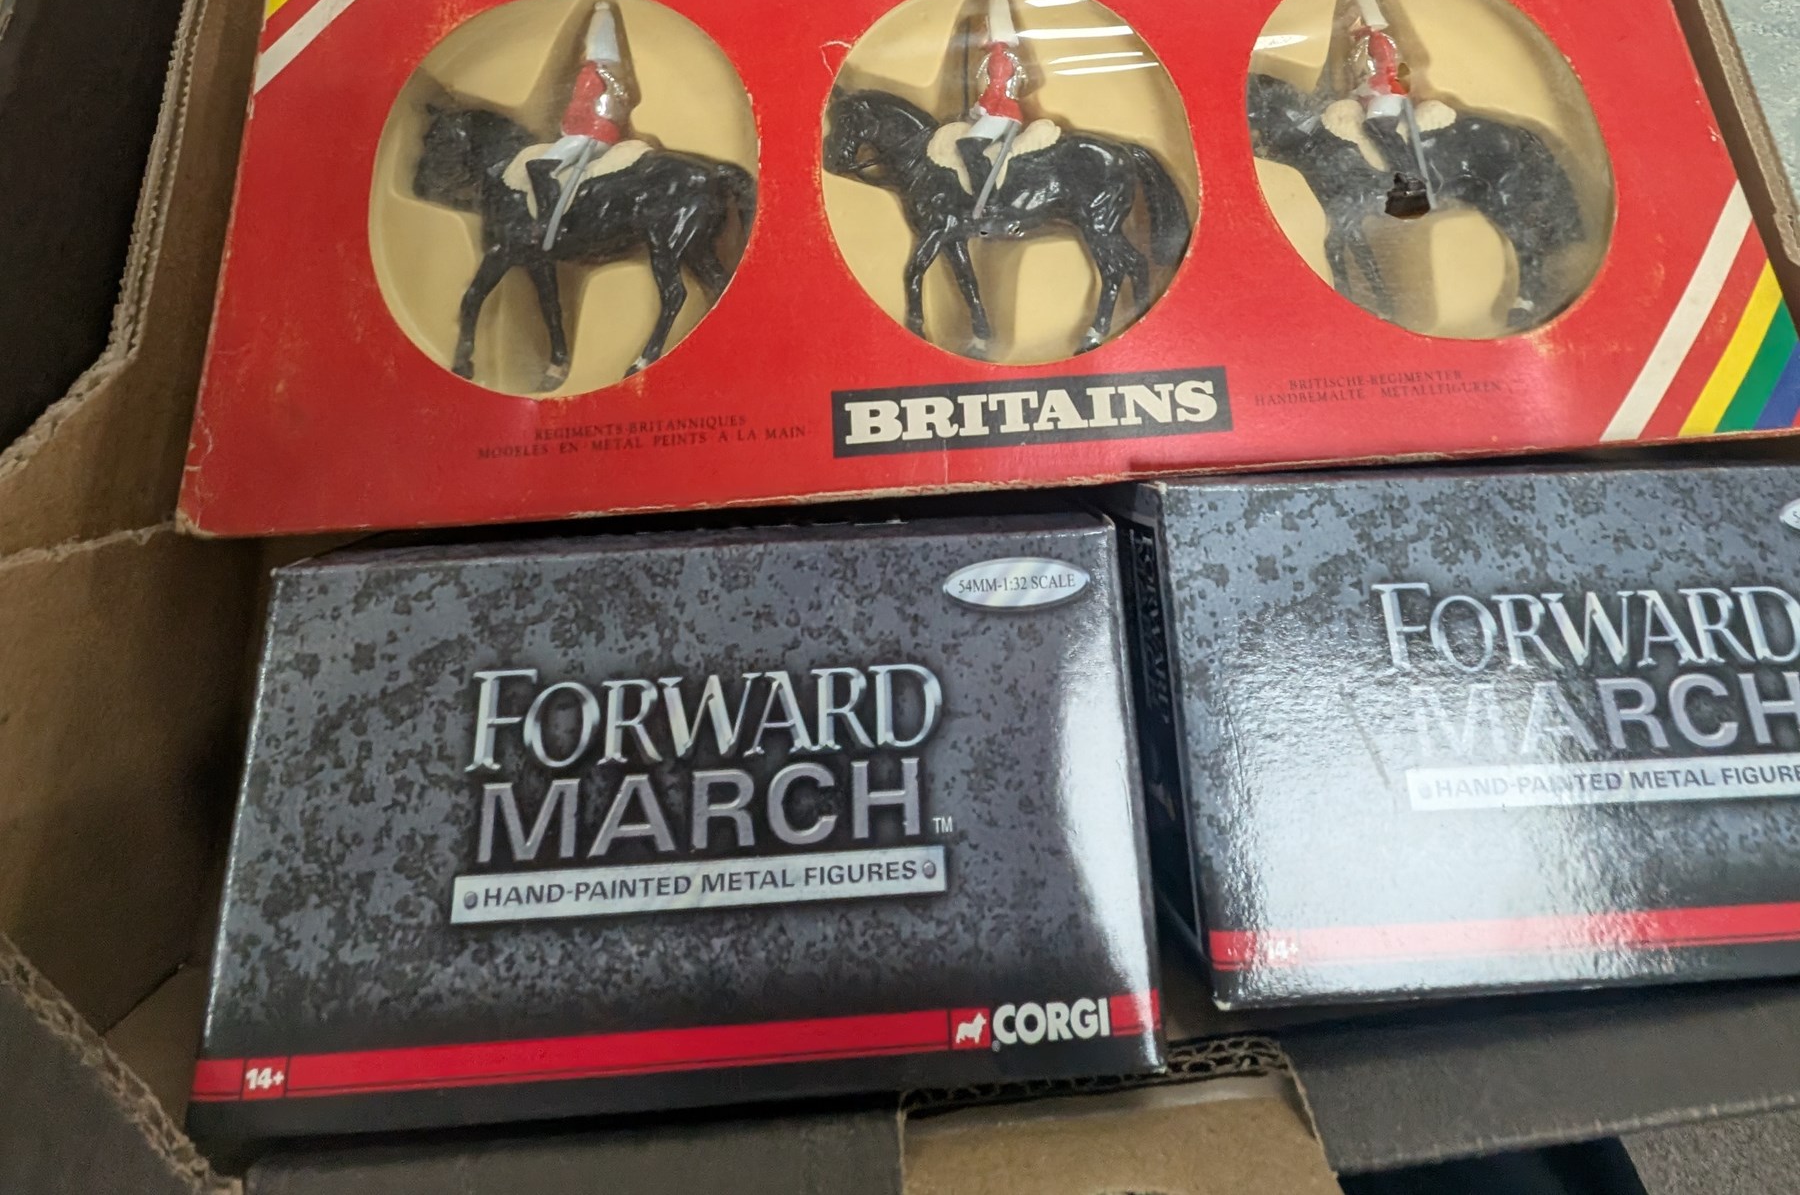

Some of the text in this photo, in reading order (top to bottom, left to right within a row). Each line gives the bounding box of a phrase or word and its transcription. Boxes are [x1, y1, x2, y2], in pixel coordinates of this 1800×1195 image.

[844, 380, 1218, 445] BRITAINS
[559, 440, 579, 454] EN
[653, 432, 708, 448] PEINTS
[737, 427, 757, 442] LA
[765, 425, 807, 441] MAIN
[958, 573, 1076, 594] 54MM-1:32 SCALE
[1371, 582, 1800, 674] FORWARD
[464, 663, 943, 772] FORWARD
[1410, 671, 1800, 759] MARCH
[1434, 771, 1623, 799] HAND-PAINTED
[1631, 768, 1715, 789] METAL
[476, 757, 922, 864] MARCH
[483, 859, 917, 909] HAND-PAINTED METAL FIGURES
[992, 997, 1110, 1045] CORGI
[245, 1067, 285, 1090] 14+
